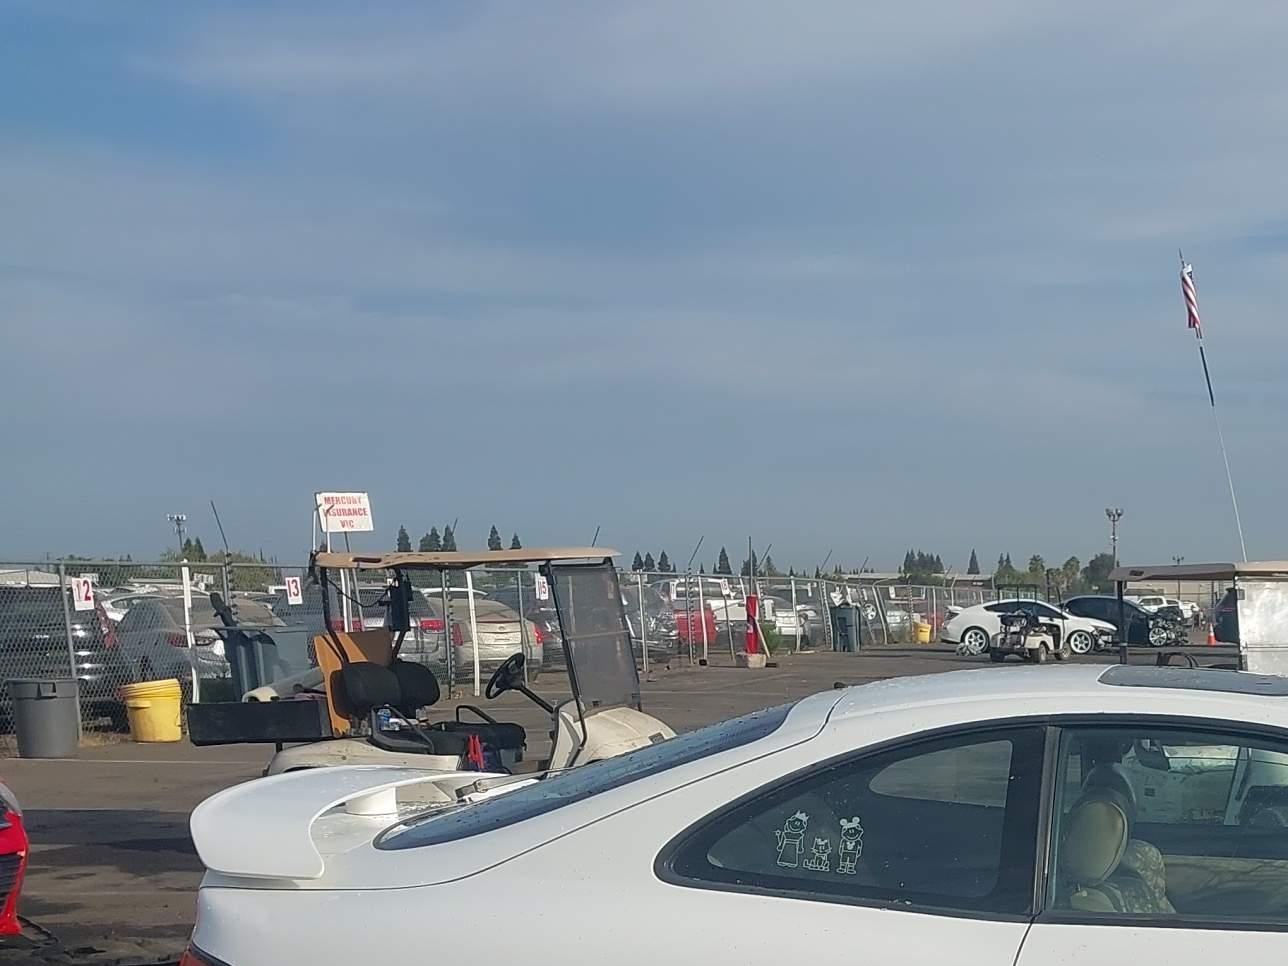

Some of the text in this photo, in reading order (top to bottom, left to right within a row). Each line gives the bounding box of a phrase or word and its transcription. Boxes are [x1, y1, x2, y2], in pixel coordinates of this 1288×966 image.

[324, 496, 362, 505] MERCURY
[340, 520, 354, 528] VIC
[287, 579, 300, 598] 13
